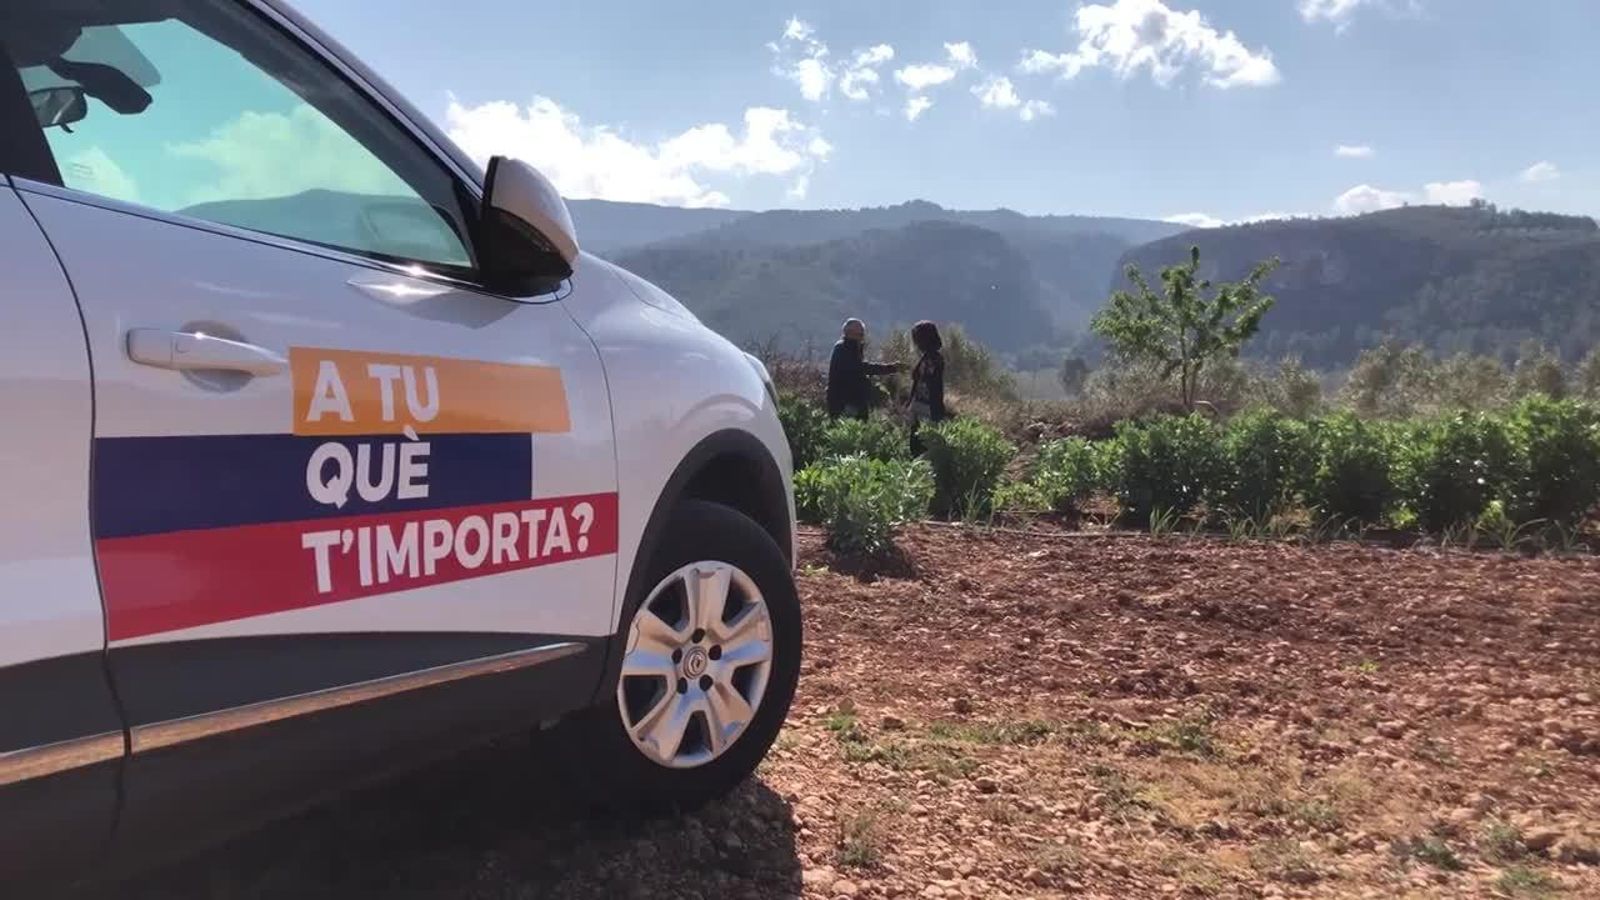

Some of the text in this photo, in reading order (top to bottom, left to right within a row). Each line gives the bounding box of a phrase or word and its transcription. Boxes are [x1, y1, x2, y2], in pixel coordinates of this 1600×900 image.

[306, 360, 440, 422] A TU
[306, 426, 431, 509] QUÈ
[302, 502, 594, 593] T'IMPORTA?
